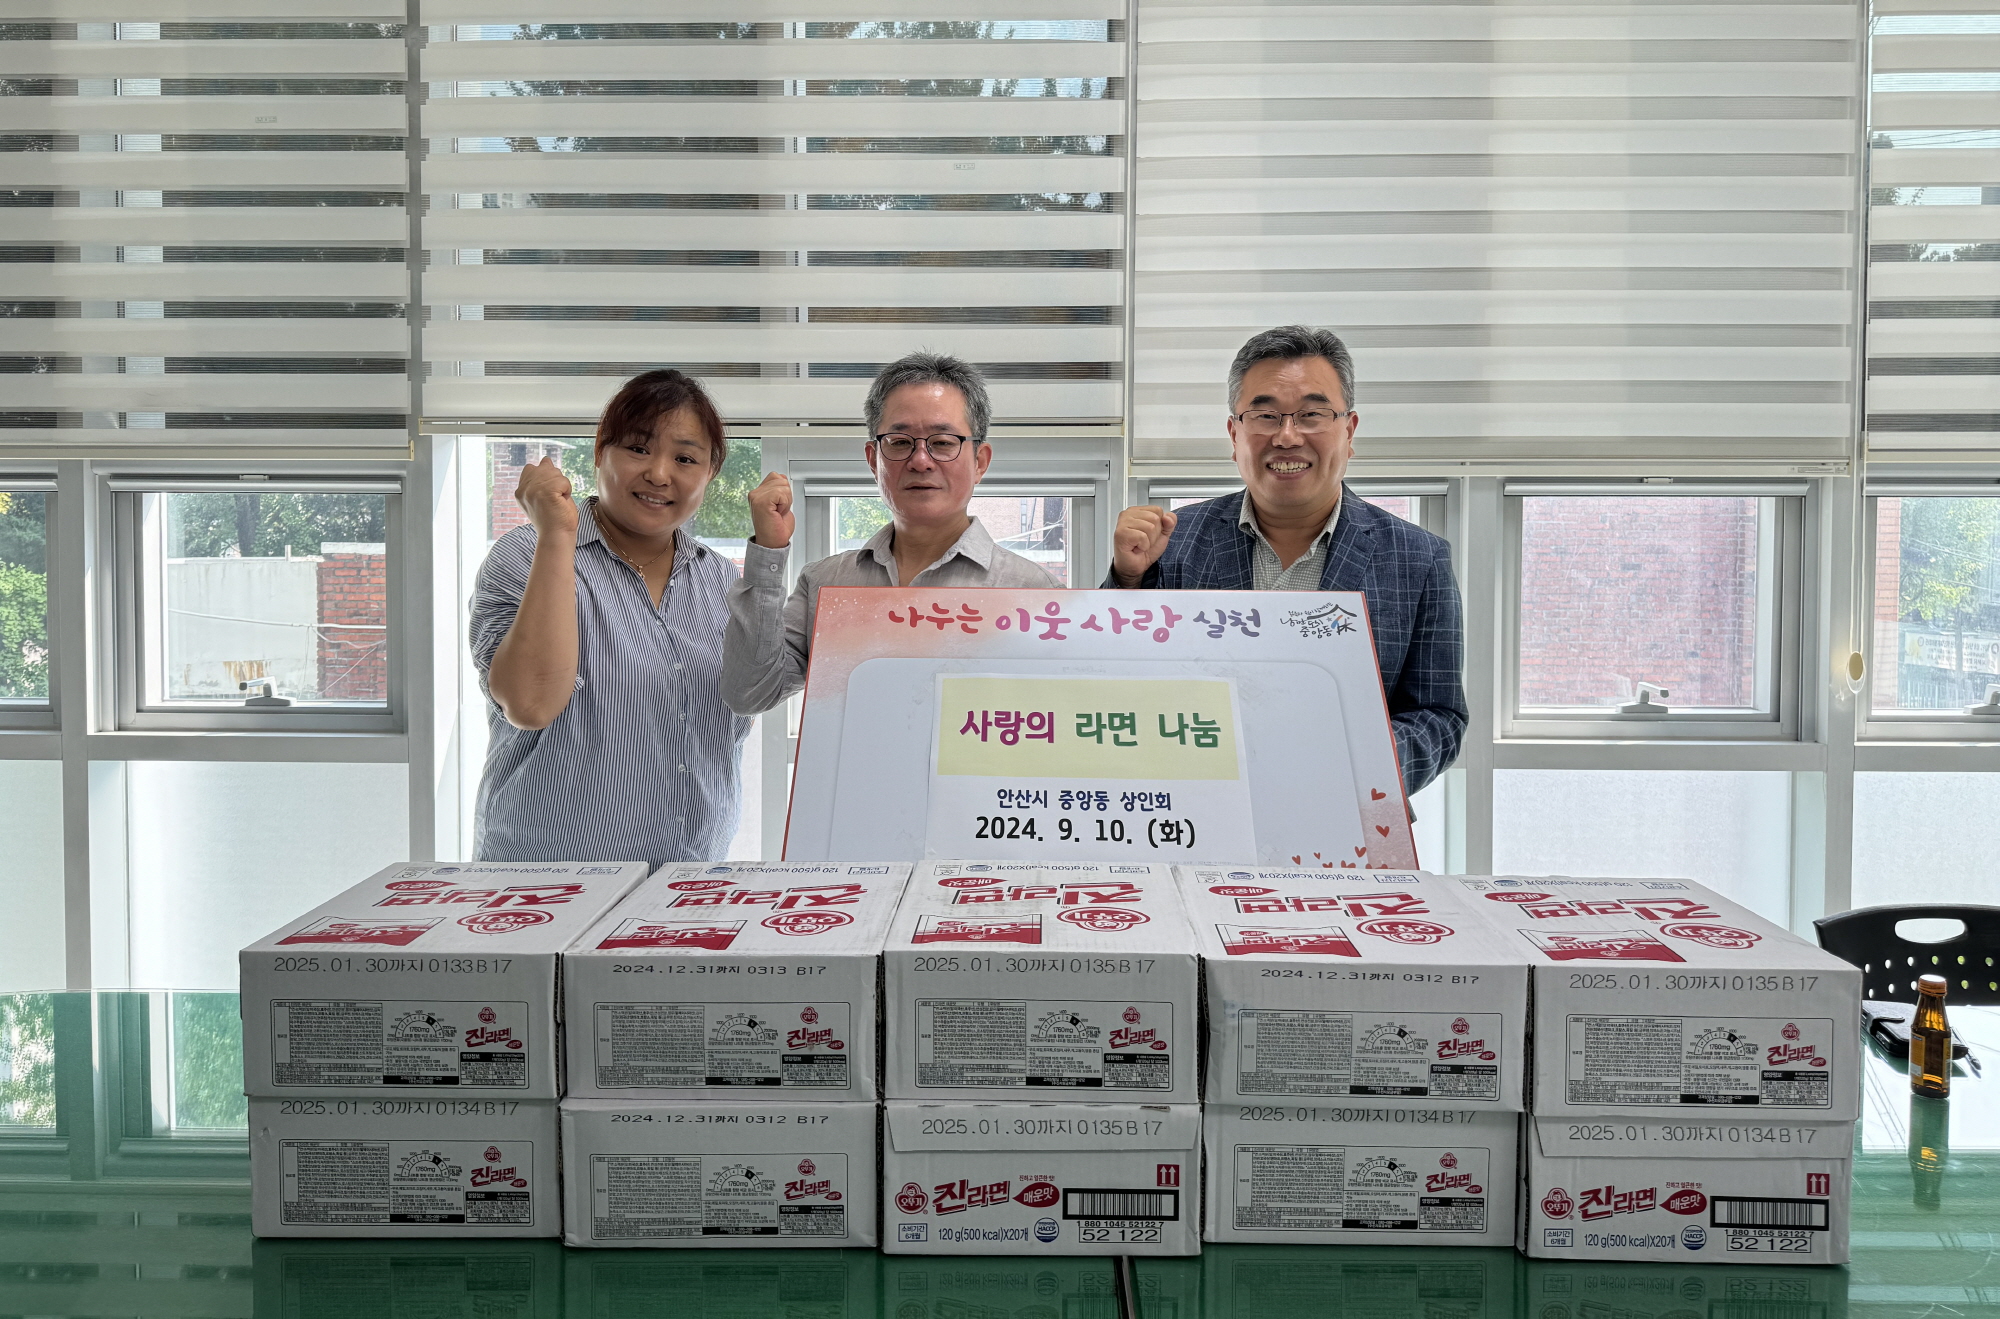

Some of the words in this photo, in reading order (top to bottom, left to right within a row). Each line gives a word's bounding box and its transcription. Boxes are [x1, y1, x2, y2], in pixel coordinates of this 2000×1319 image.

[888, 602, 983, 634] 나누는
[995, 601, 1071, 641] 이웃
[1080, 604, 1183, 643] 사랑
[1193, 607, 1262, 639] 실천
[1300, 625, 1333, 639] 중앙동
[959, 710, 1055, 746] 사랑의
[1075, 711, 1138, 747] 라면
[1158, 712, 1221, 748] 나눔
[997, 788, 1048, 809] 안산시
[1058, 790, 1110, 811] 중앙동
[1119, 791, 1172, 812] 상인회
[975, 816, 1044, 842] 2024.
[1058, 818, 1080, 843] 9.
[1095, 819, 1133, 844] 10.
[1147, 818, 1196, 849] (화)
[675, 881, 724, 889] 매운맛
[947, 879, 992, 887] 매운맛
[1219, 887, 1264, 895] 매운맛
[372, 883, 586, 908] 진라면
[666, 883, 868, 910] 진라면
[951, 881, 1143, 905] 진라면
[1496, 893, 1542, 902] 매운맛
[1234, 892, 1431, 918] 진라면
[1517, 897, 1722, 921] 진라면
[475, 915, 536, 924] 오뚜기
[779, 915, 837, 925] 오뚜기
[1074, 912, 1132, 920] 오뚜기
[1373, 924, 1433, 932] 오뚜기
[1675, 925, 1738, 938] 오뚜기
[747, 965, 787, 975] 0313
[797, 966, 827, 976] B17
[1403, 973, 1443, 983] 0312
[1452, 975, 1479, 985] B17
[465, 1026, 511, 1048] 진라면
[786, 1027, 833, 1050] 진라면
[1109, 1027, 1156, 1049] 진라면
[1437, 1038, 1485, 1060] 진라면
[1767, 1044, 1815, 1066] 진라면
[745, 1115, 787, 1124] 0312
[797, 1115, 829, 1125] B17
[470, 1165, 517, 1187] 진라면
[1425, 1171, 1472, 1193] 진라면
[784, 1179, 831, 1201] 진라면
[901, 1197, 923, 1207] 오뚜기
[932, 1179, 1011, 1216] 진라면
[1023, 1186, 1054, 1203] 매운맛
[1546, 1202, 1568, 1213] 오뚜기
[1577, 1185, 1657, 1222] 진라면
[1670, 1193, 1701, 1210] 매운맛
[905, 1232, 921, 1240] 6개월
[938, 1228, 953, 1240] 120
[955, 1227, 979, 1242] g(500
[1082, 1229, 1110, 1241] 52
[1118, 1229, 1158, 1241] 122
[1584, 1234, 1598, 1247] 120
[1600, 1233, 1626, 1248] g(500
[1730, 1237, 1759, 1250] 52
[1767, 1238, 1808, 1251] 122
